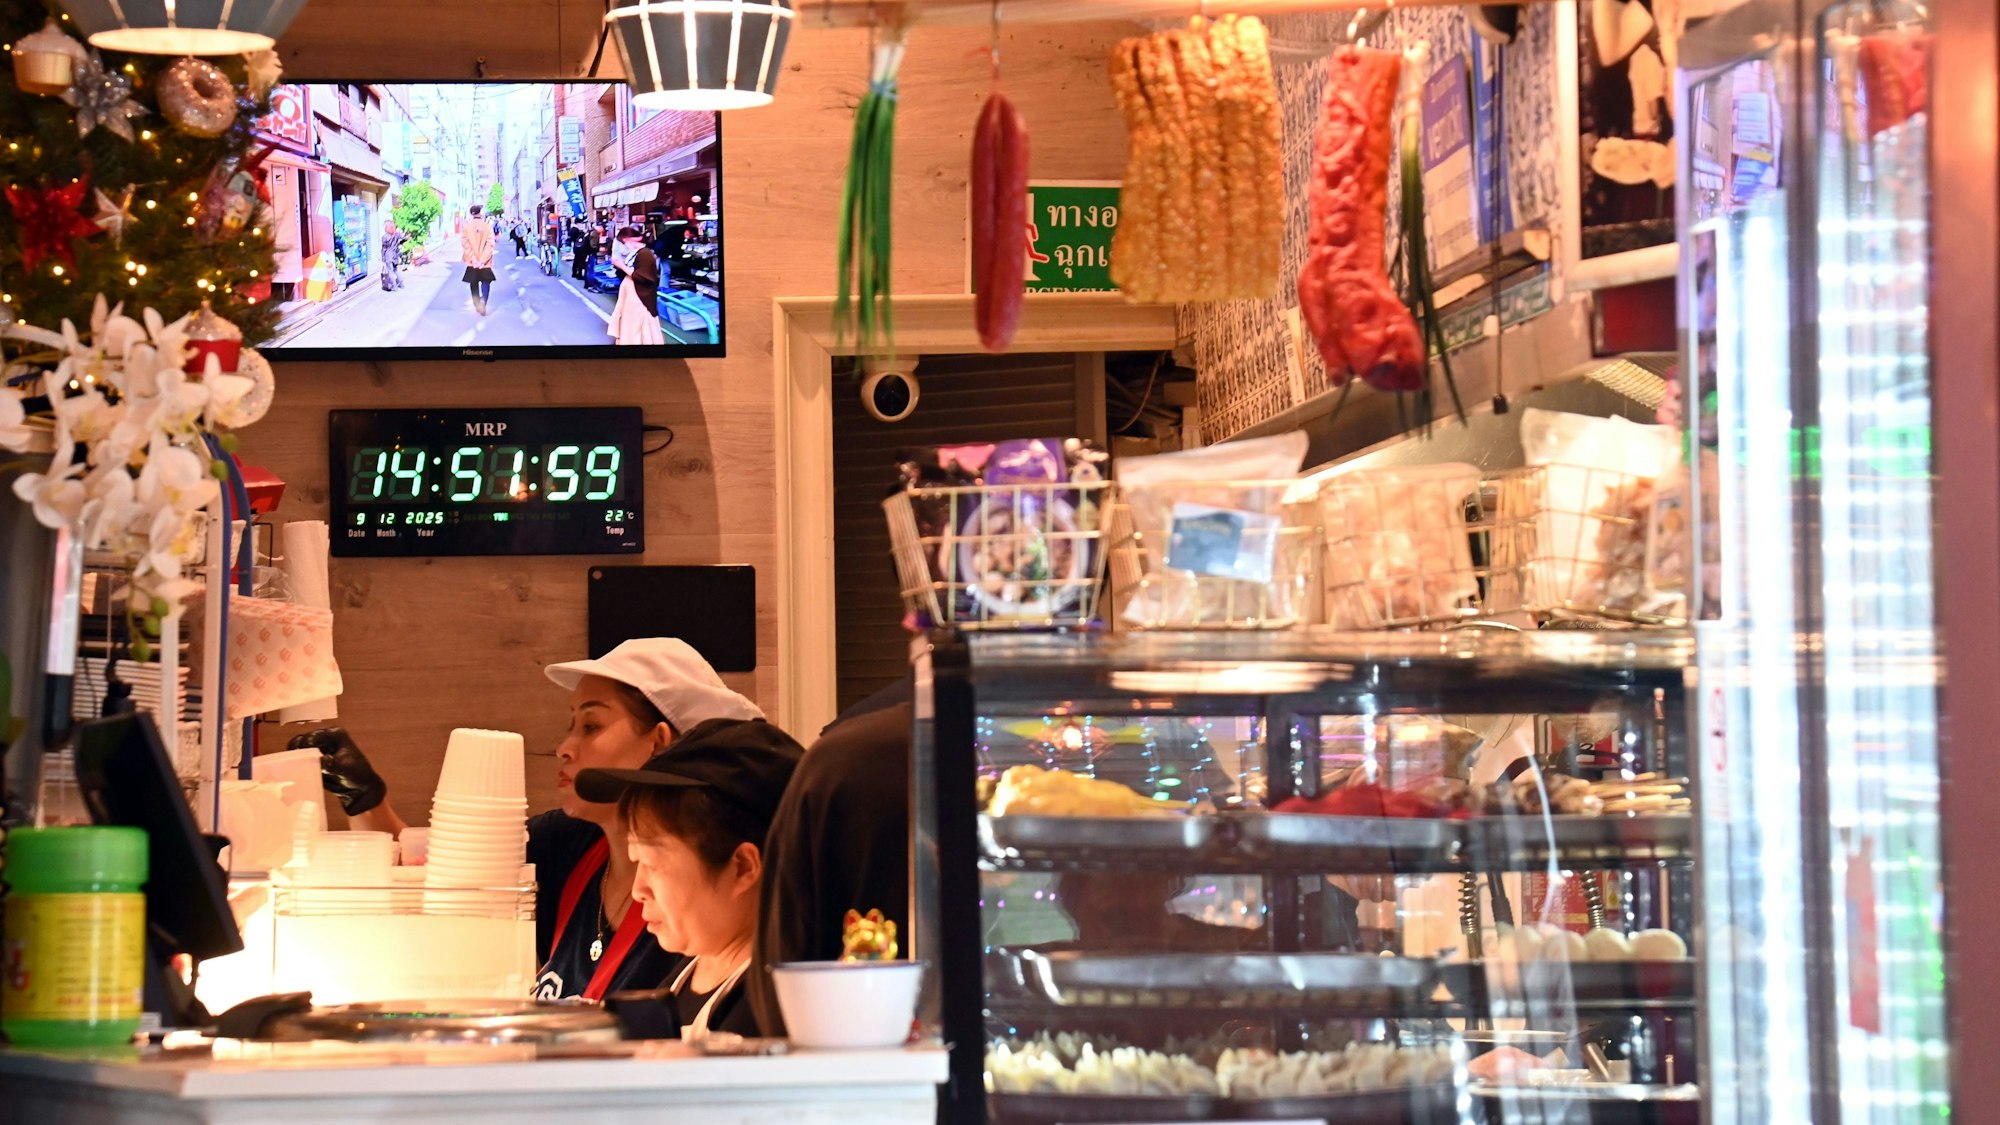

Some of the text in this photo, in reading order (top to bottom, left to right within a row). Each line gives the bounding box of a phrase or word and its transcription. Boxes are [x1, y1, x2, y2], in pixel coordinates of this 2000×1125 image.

[1047, 205, 1118, 227] ทางอ
[1054, 244, 1112, 279] ฉุกเ
[465, 422, 508, 437] MRP
[372, 445, 621, 502] 14:51:59
[356, 511, 444, 525] 9 12 2025
[604, 509, 625, 522] 22
[348, 528, 435, 538] Date Month Year
[605, 525, 625, 536] Temp
